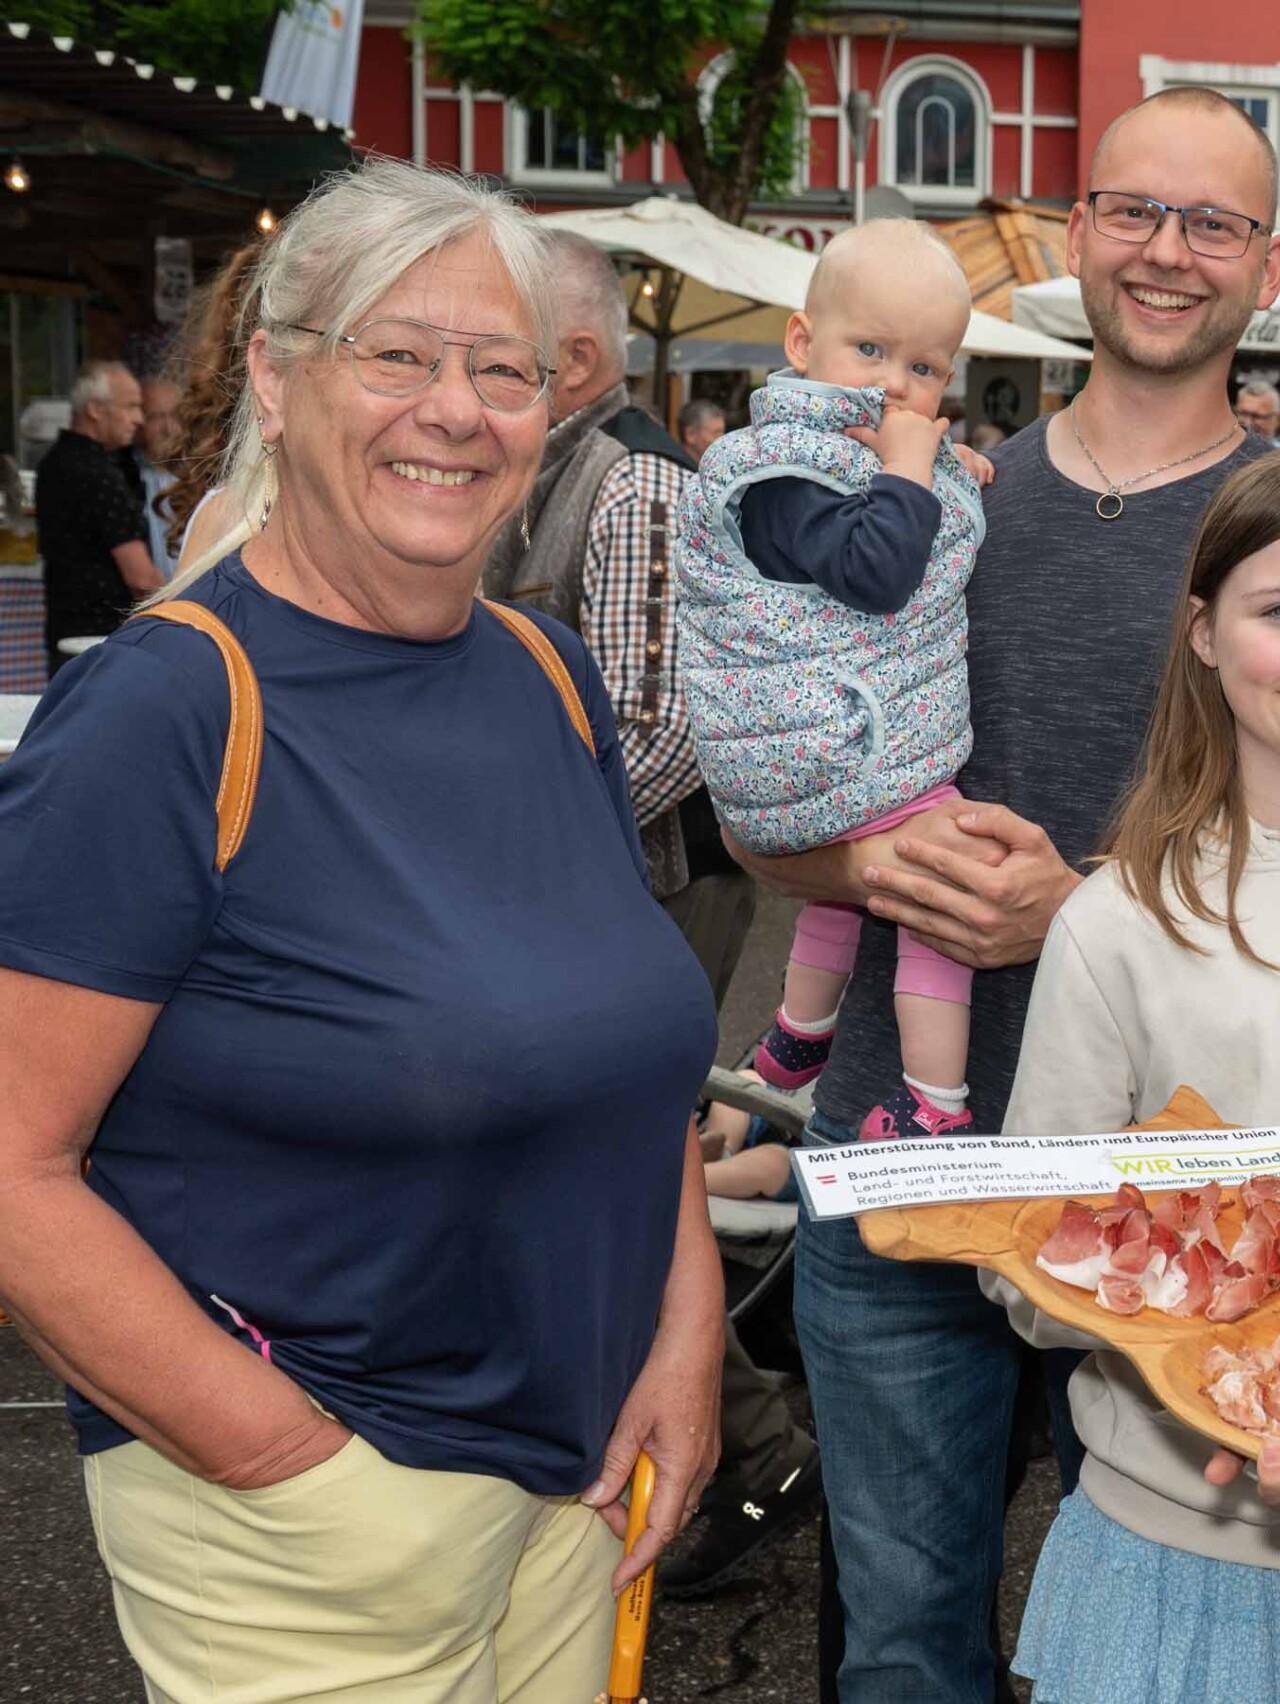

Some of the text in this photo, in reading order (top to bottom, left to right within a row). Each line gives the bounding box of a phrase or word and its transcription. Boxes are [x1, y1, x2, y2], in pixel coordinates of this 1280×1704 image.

[808, 1128, 1277, 1163] Mit Unterstützung von Bund, Ländern und Europäischer Union
[848, 1161, 1002, 1181] Bundesministerium
[1112, 1158, 1174, 1175] WIR
[1176, 1157, 1232, 1169] leben
[853, 1170, 1068, 1194] Land- und Forstwirtschaft,
[857, 1180, 1112, 1206] Regionen und Wasserwirtschaft
